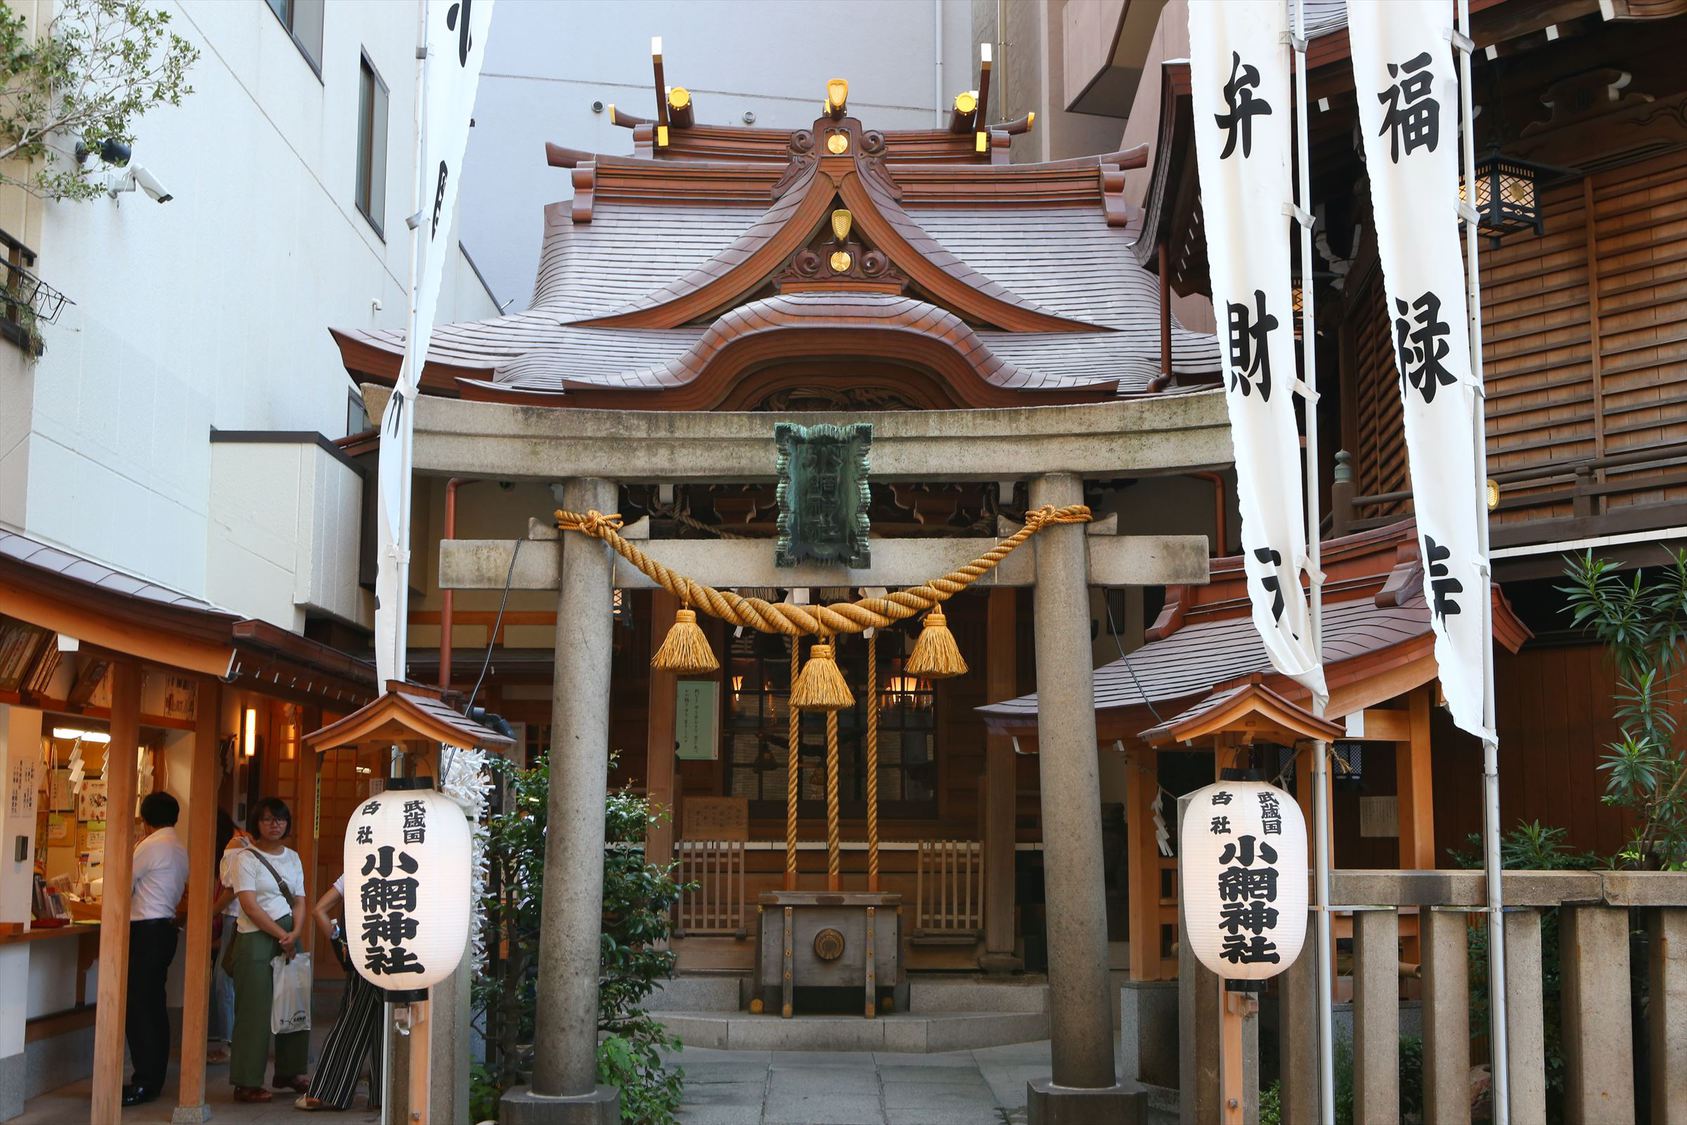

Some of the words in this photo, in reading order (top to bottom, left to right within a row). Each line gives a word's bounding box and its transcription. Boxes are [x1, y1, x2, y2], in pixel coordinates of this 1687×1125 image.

[402, 799, 426, 845] 武蔵国
[1257, 790, 1283, 836] 武蔵国
[360, 845, 425, 976] 小網神社
[1218, 834, 1281, 965] 小網神社
